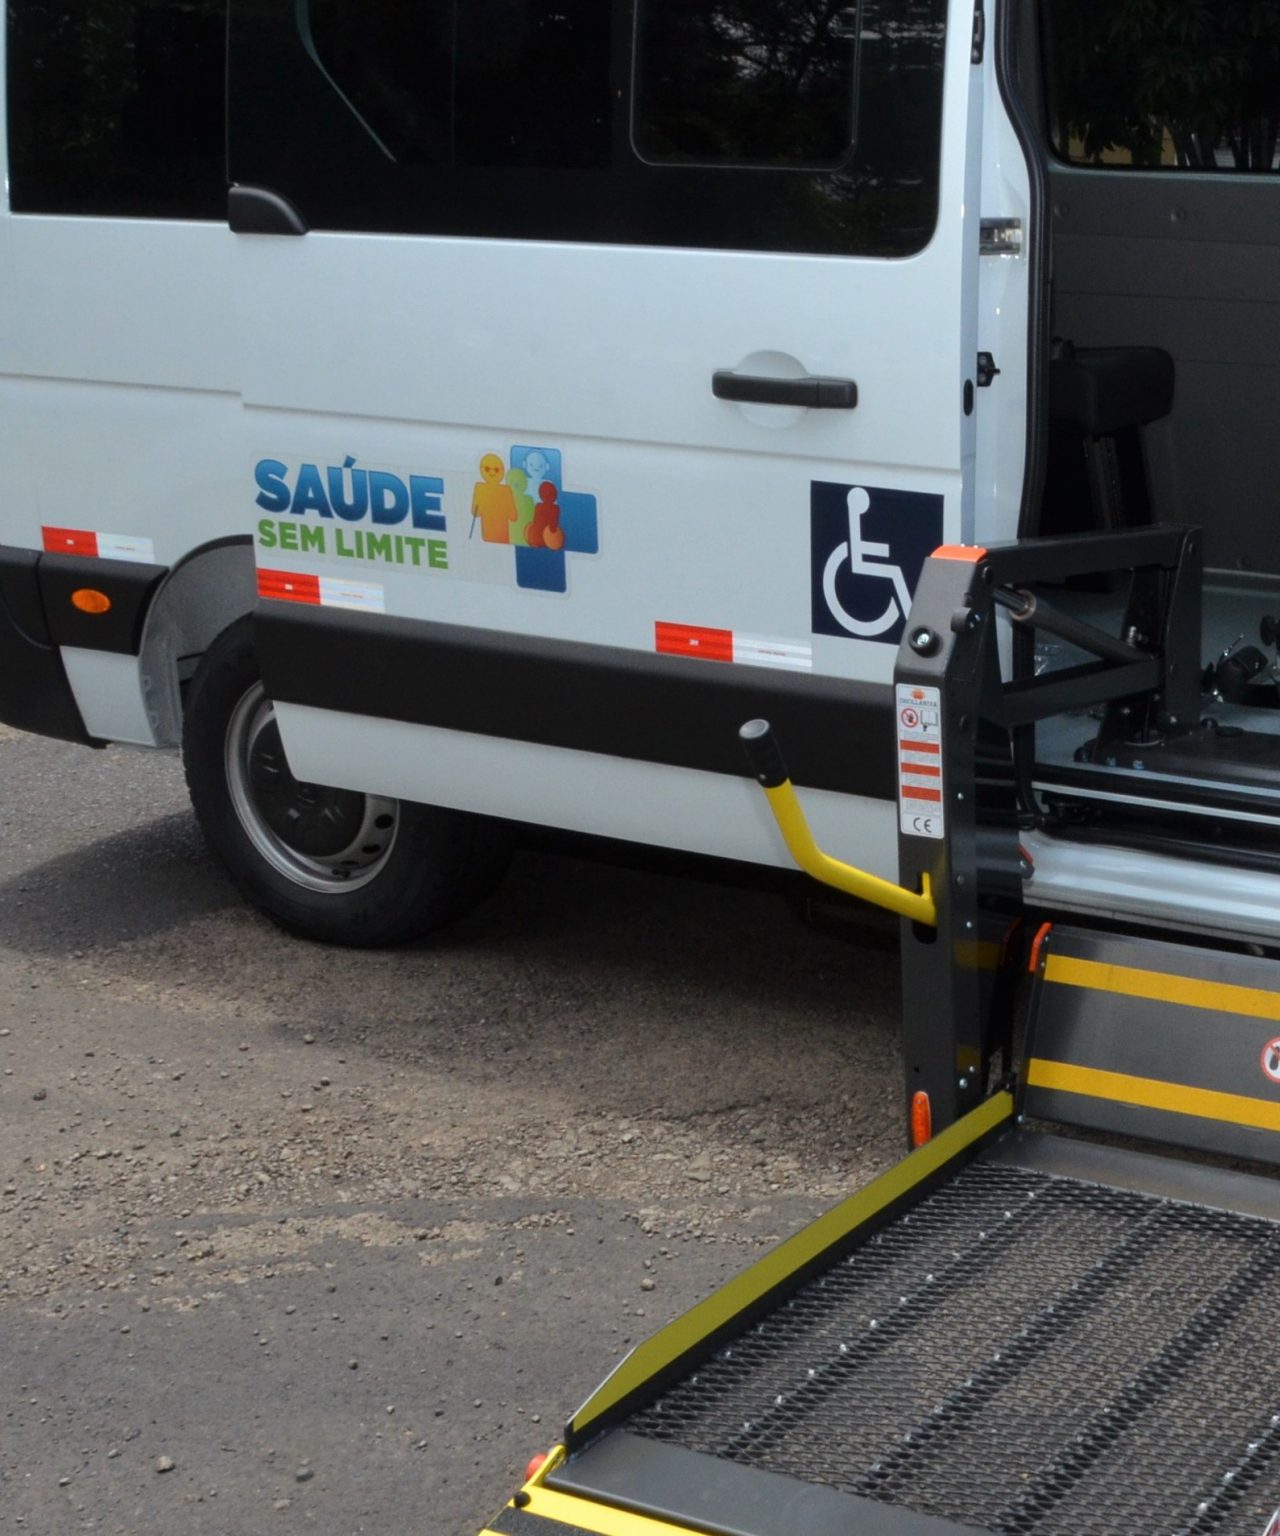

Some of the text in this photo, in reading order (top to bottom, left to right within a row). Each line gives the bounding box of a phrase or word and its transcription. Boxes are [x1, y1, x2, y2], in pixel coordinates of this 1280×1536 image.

[255, 455, 447, 532] SAÚDE
[258, 519, 449, 569] SEM LIMITE
[913, 817, 931, 833] CE
